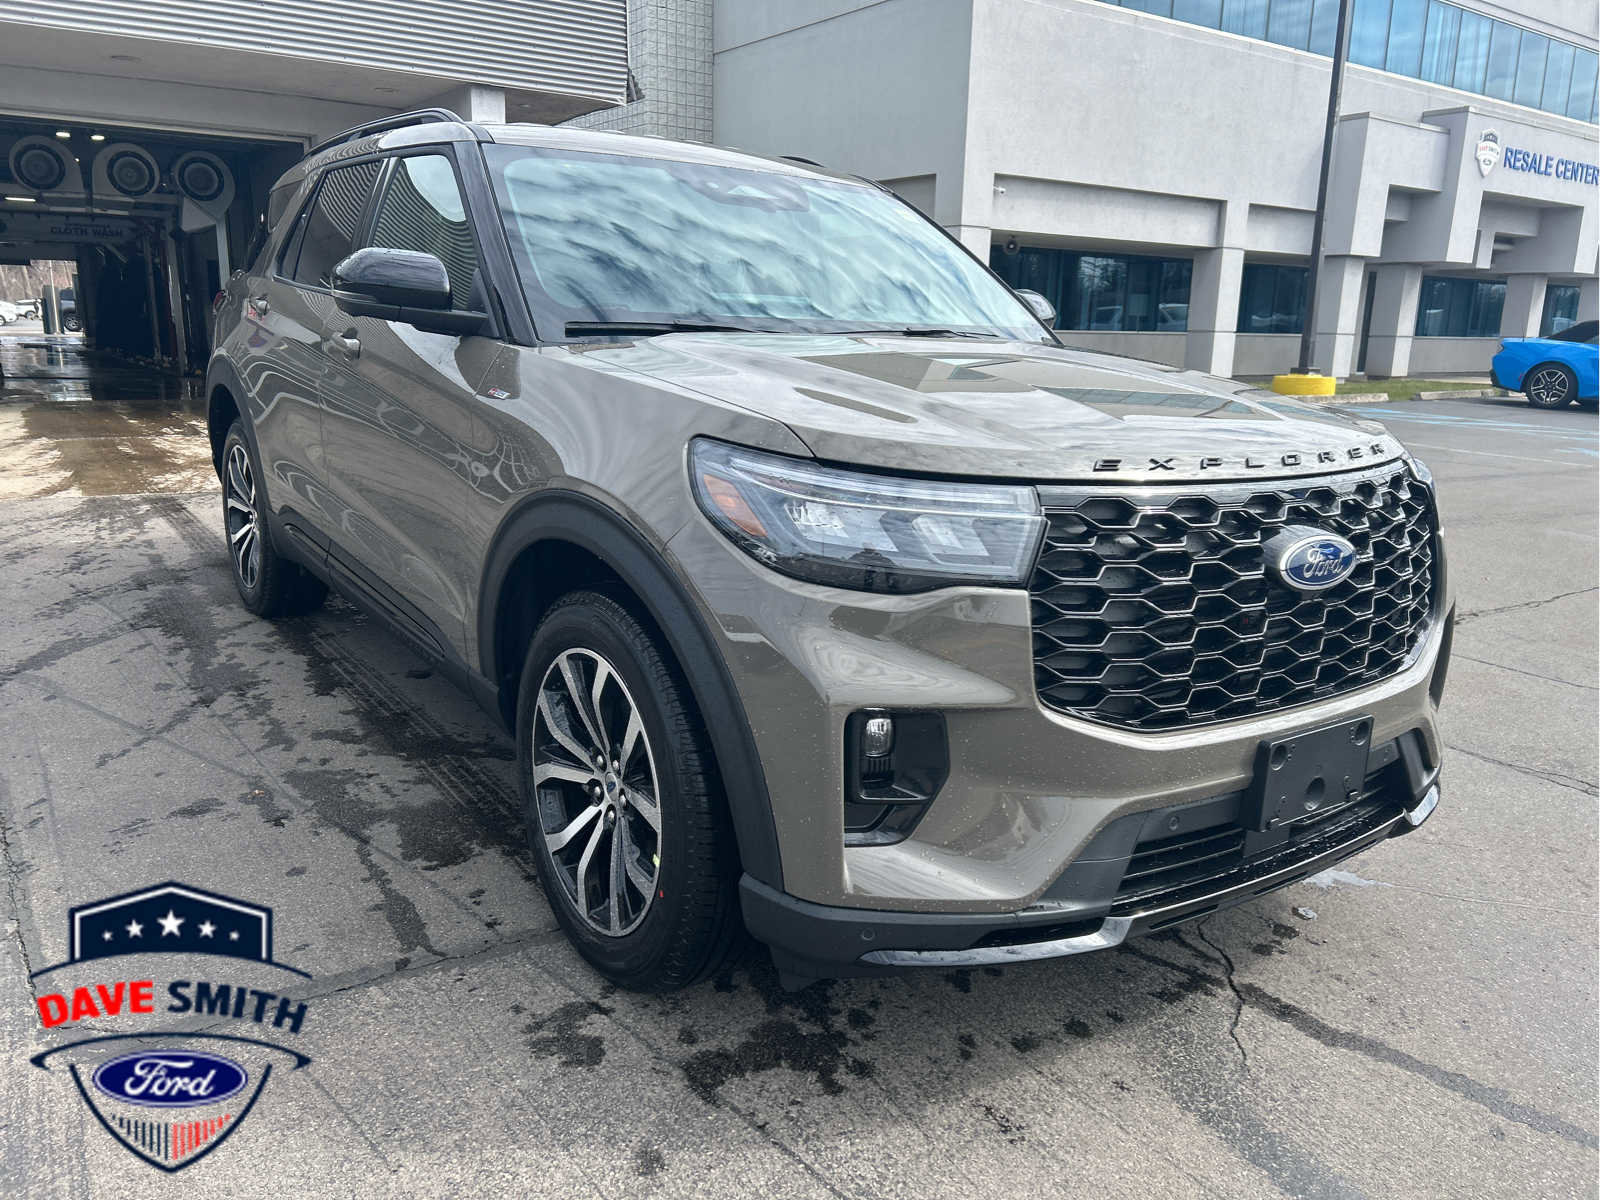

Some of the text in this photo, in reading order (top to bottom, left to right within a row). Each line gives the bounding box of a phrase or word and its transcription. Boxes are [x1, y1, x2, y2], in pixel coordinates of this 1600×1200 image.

[1503, 146, 1600, 186] RESALE CENTER
[93, 228, 123, 238] WASH
[1093, 443, 1385, 472] EXPLORER
[1301, 546, 1345, 578] Ford
